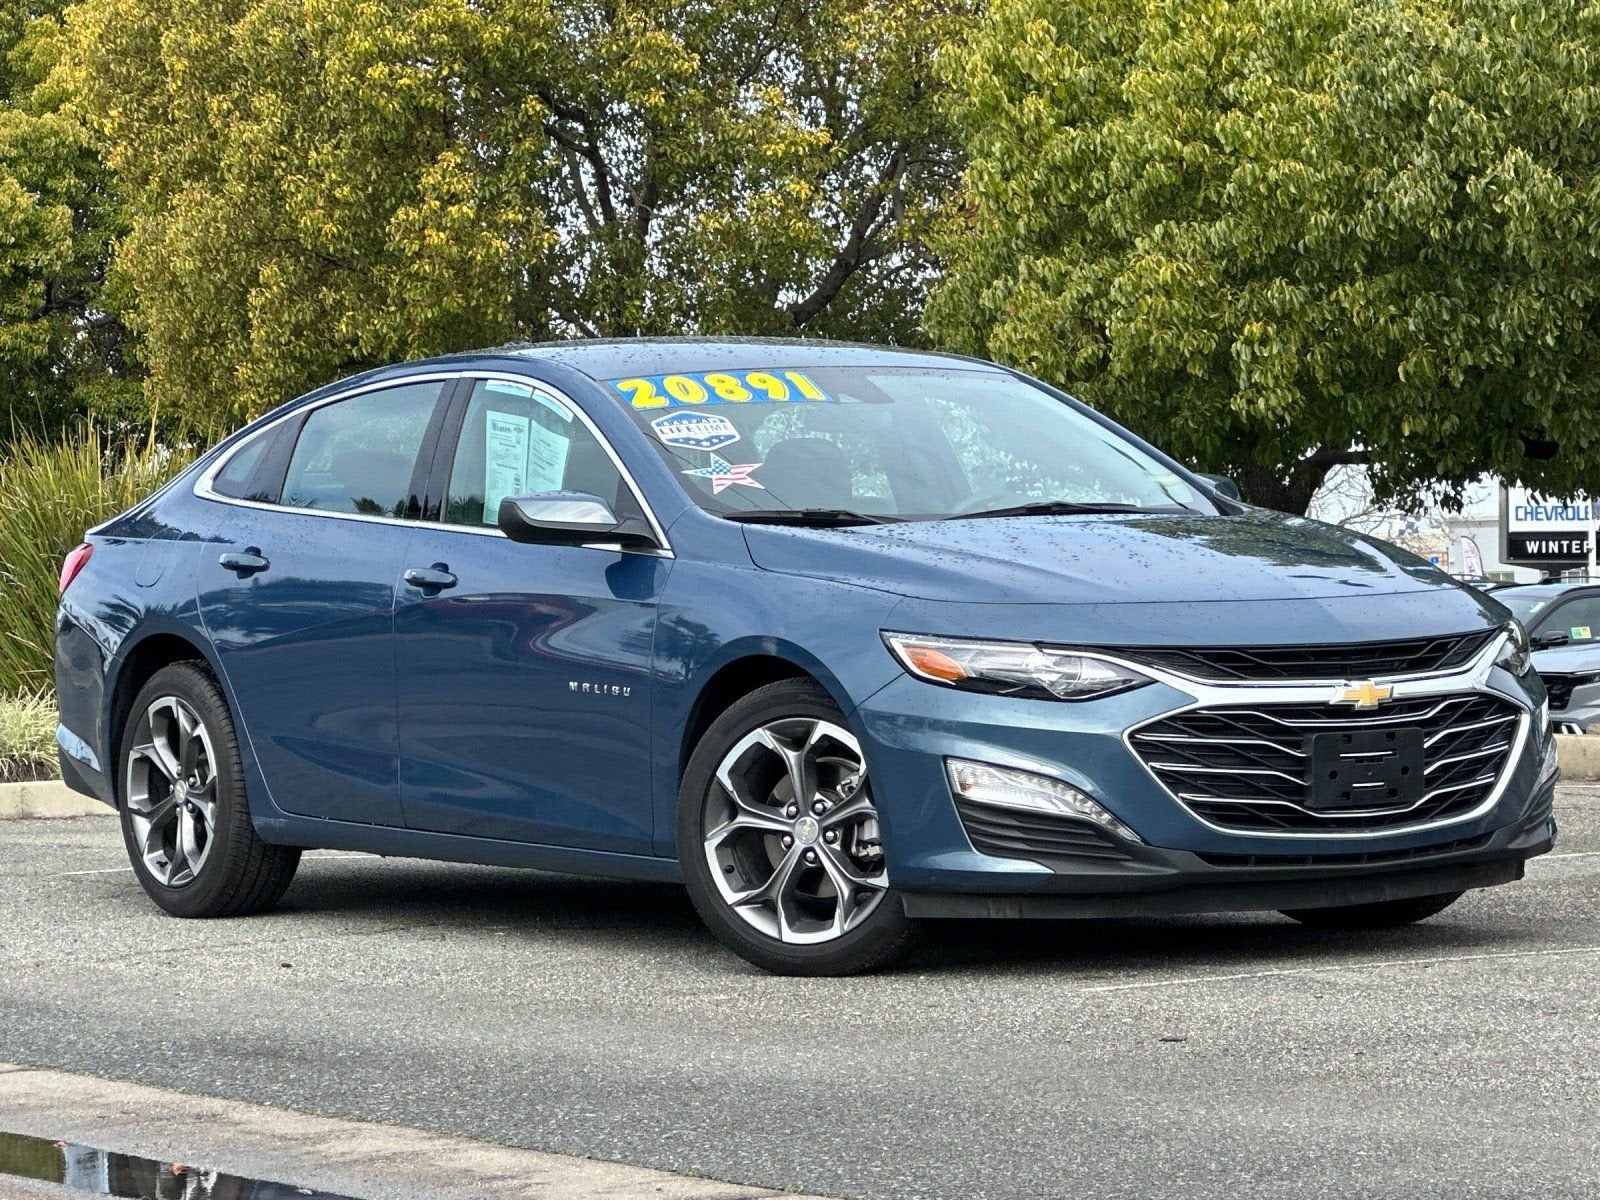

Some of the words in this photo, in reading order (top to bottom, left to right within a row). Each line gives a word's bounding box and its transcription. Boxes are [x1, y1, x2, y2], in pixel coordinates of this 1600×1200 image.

[616, 371, 828, 409] 20891
[1515, 505, 1590, 521] CHEVROLE
[568, 681, 631, 697] MALIBU
